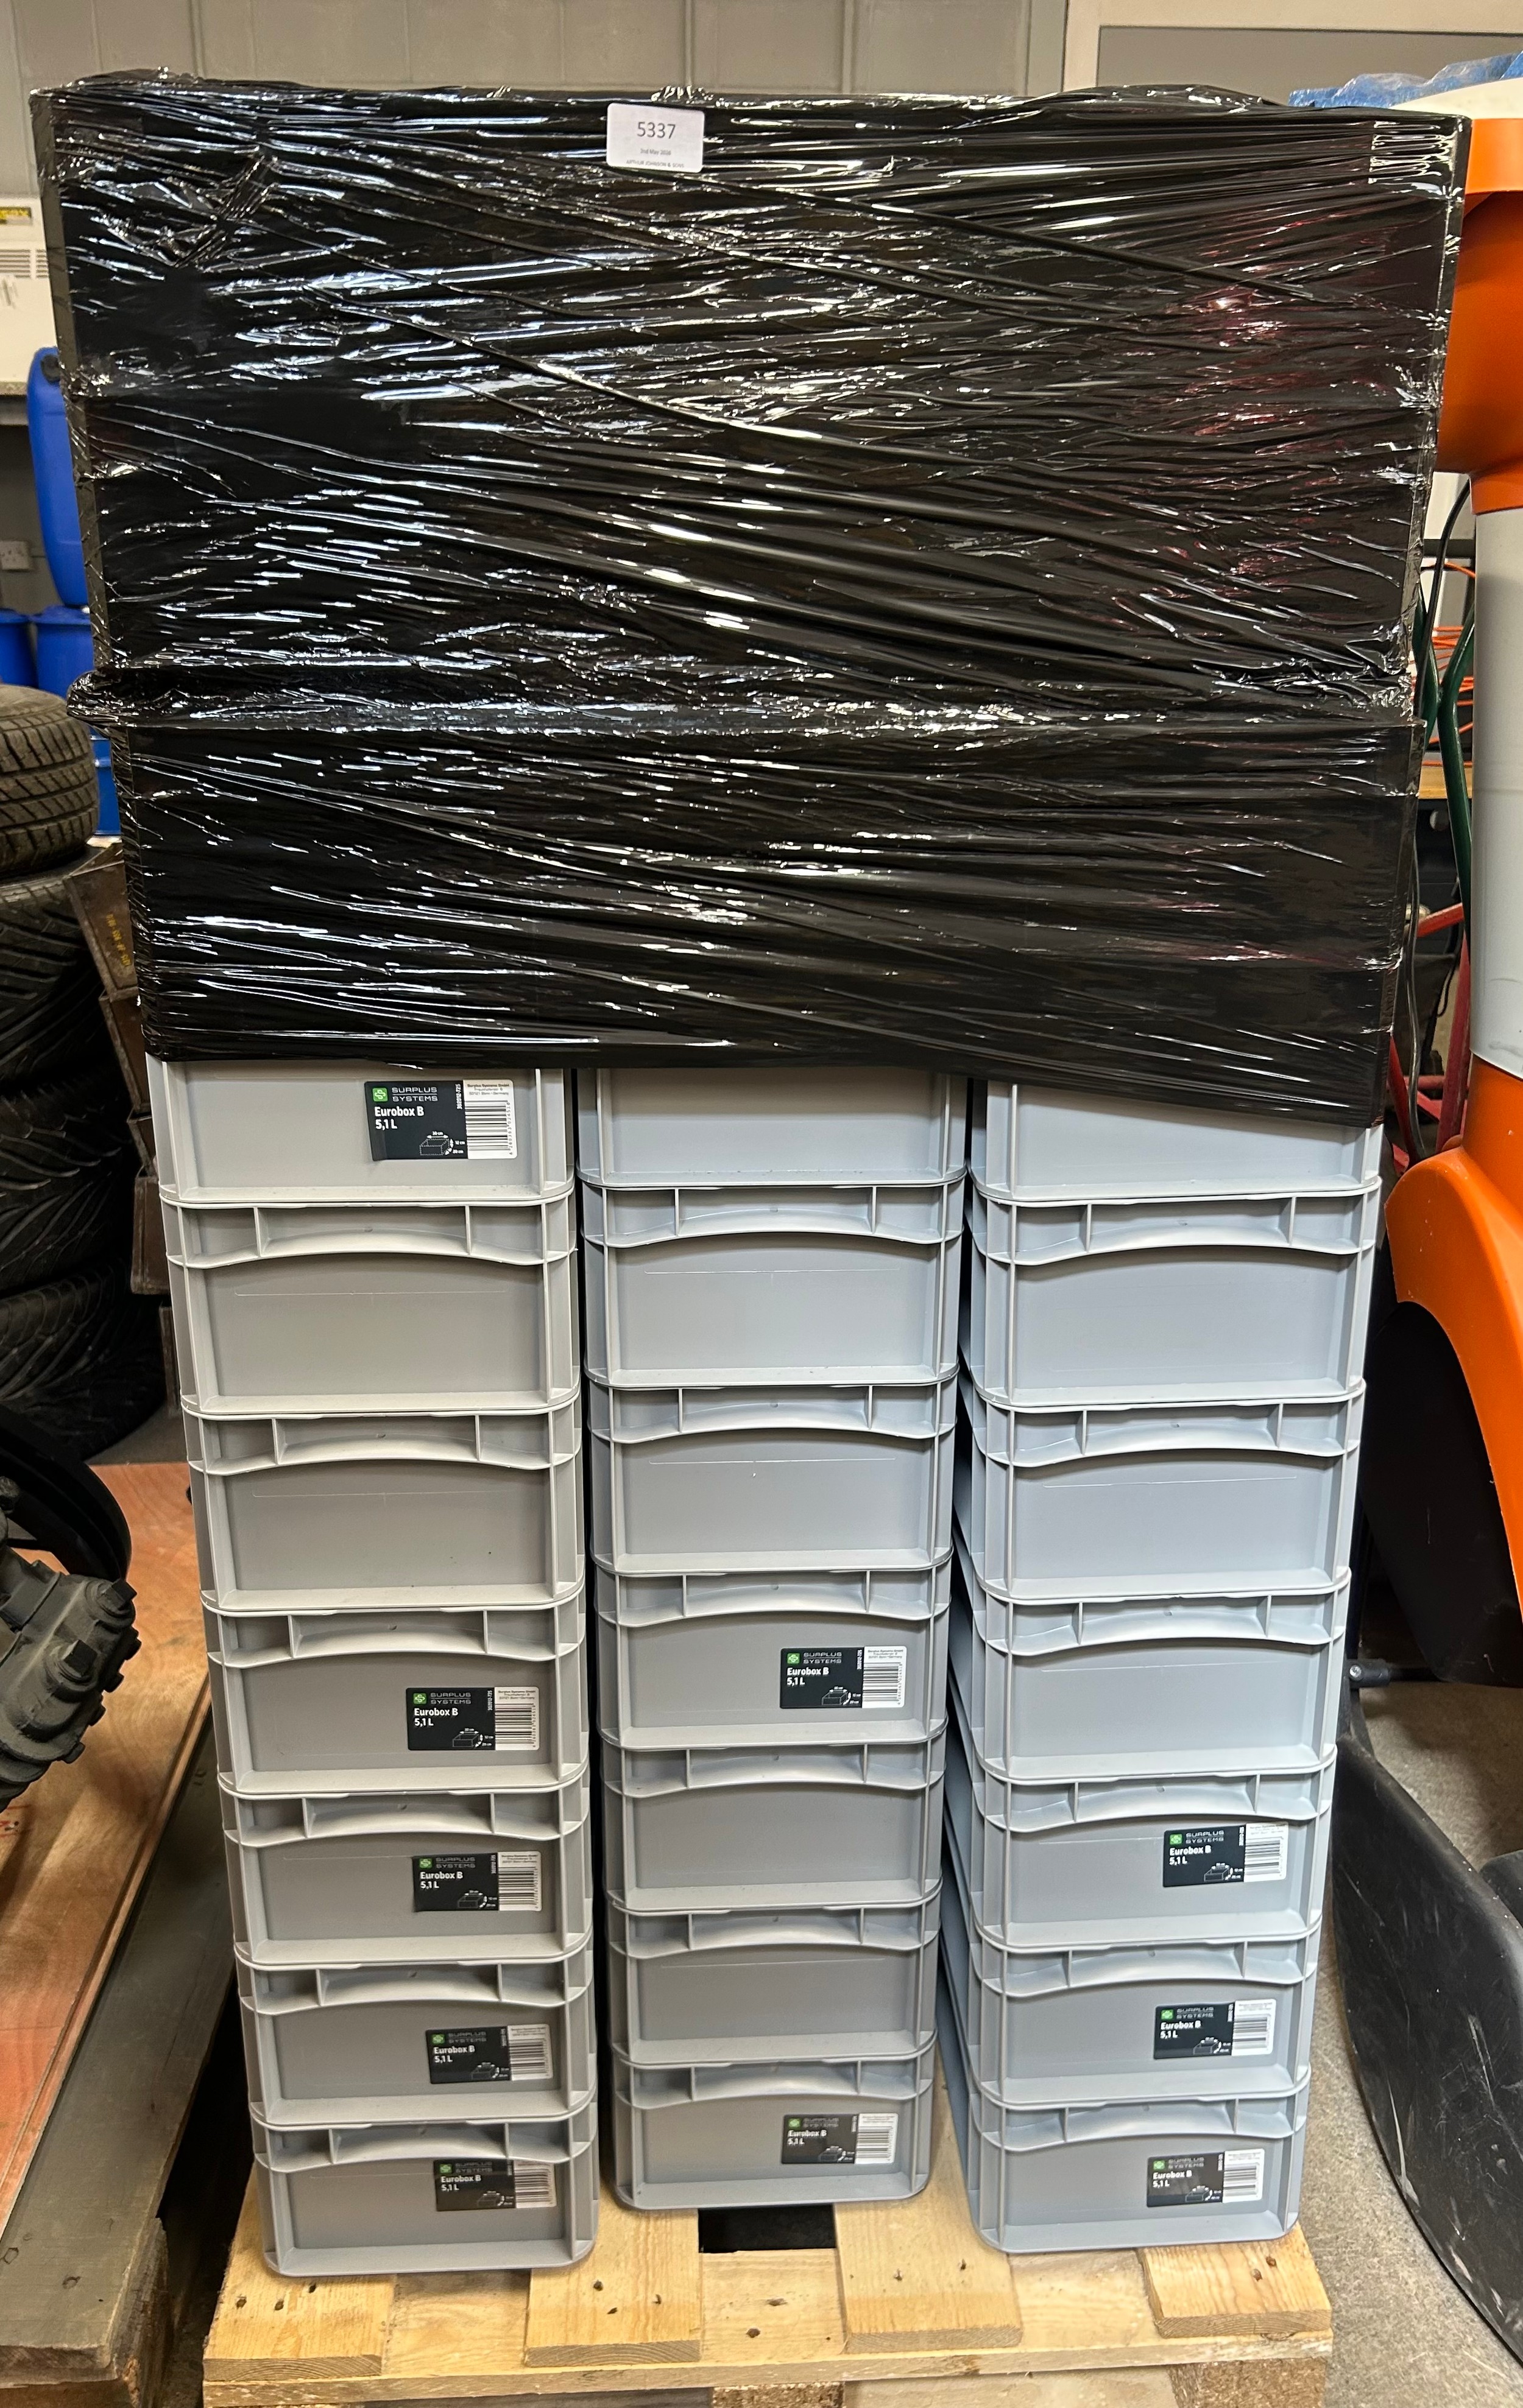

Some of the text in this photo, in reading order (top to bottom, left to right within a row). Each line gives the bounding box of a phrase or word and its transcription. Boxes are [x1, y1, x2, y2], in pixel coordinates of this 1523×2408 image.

[637, 121, 676, 139] 5337
[374, 1106, 424, 1117] Eurobox B
[375, 1119, 398, 1130] 5,1 L
[786, 1667, 829, 1675] Eurobox B
[786, 1677, 799, 1686] 5,1
[414, 1708, 450, 1716] Eurobox
[414, 1718, 426, 1728] 5,1
[1170, 1845, 1212, 1856] Eurobox B
[1169, 1857, 1181, 1866] 5,1
[420, 1881, 433, 1890] 5,1
[1161, 2020, 1201, 2030] Eurobox B
[1153, 2170, 1186, 2180] Eurobox
